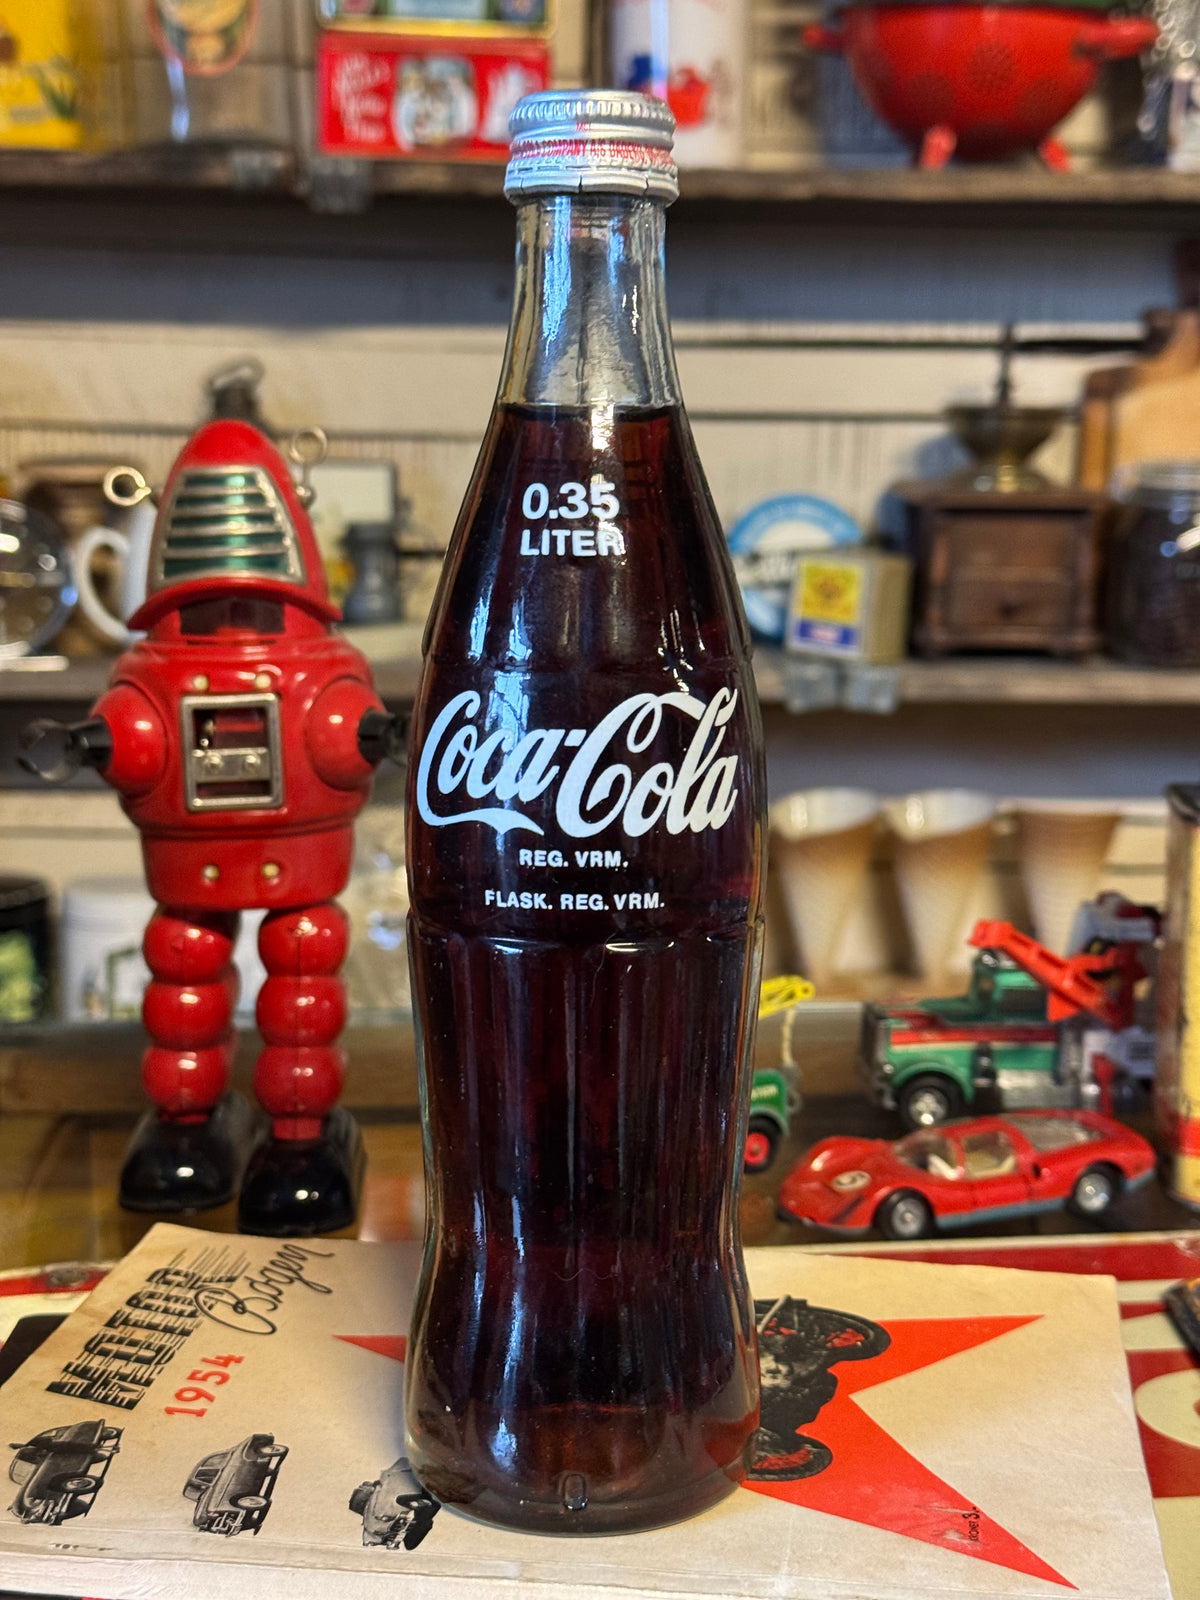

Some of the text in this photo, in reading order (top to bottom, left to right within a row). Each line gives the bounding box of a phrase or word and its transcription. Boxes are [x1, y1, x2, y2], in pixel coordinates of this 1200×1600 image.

[541, 138, 588, 158] COMPANY
[522, 482, 620, 520] 0.35
[520, 528, 625, 557] LITER
[416, 686, 739, 838] Coca-Cola
[519, 849, 629, 868] REG. VRM.
[485, 889, 665, 911] FLASK. REG. VRM.
[163, 1353, 245, 1418] 1954
